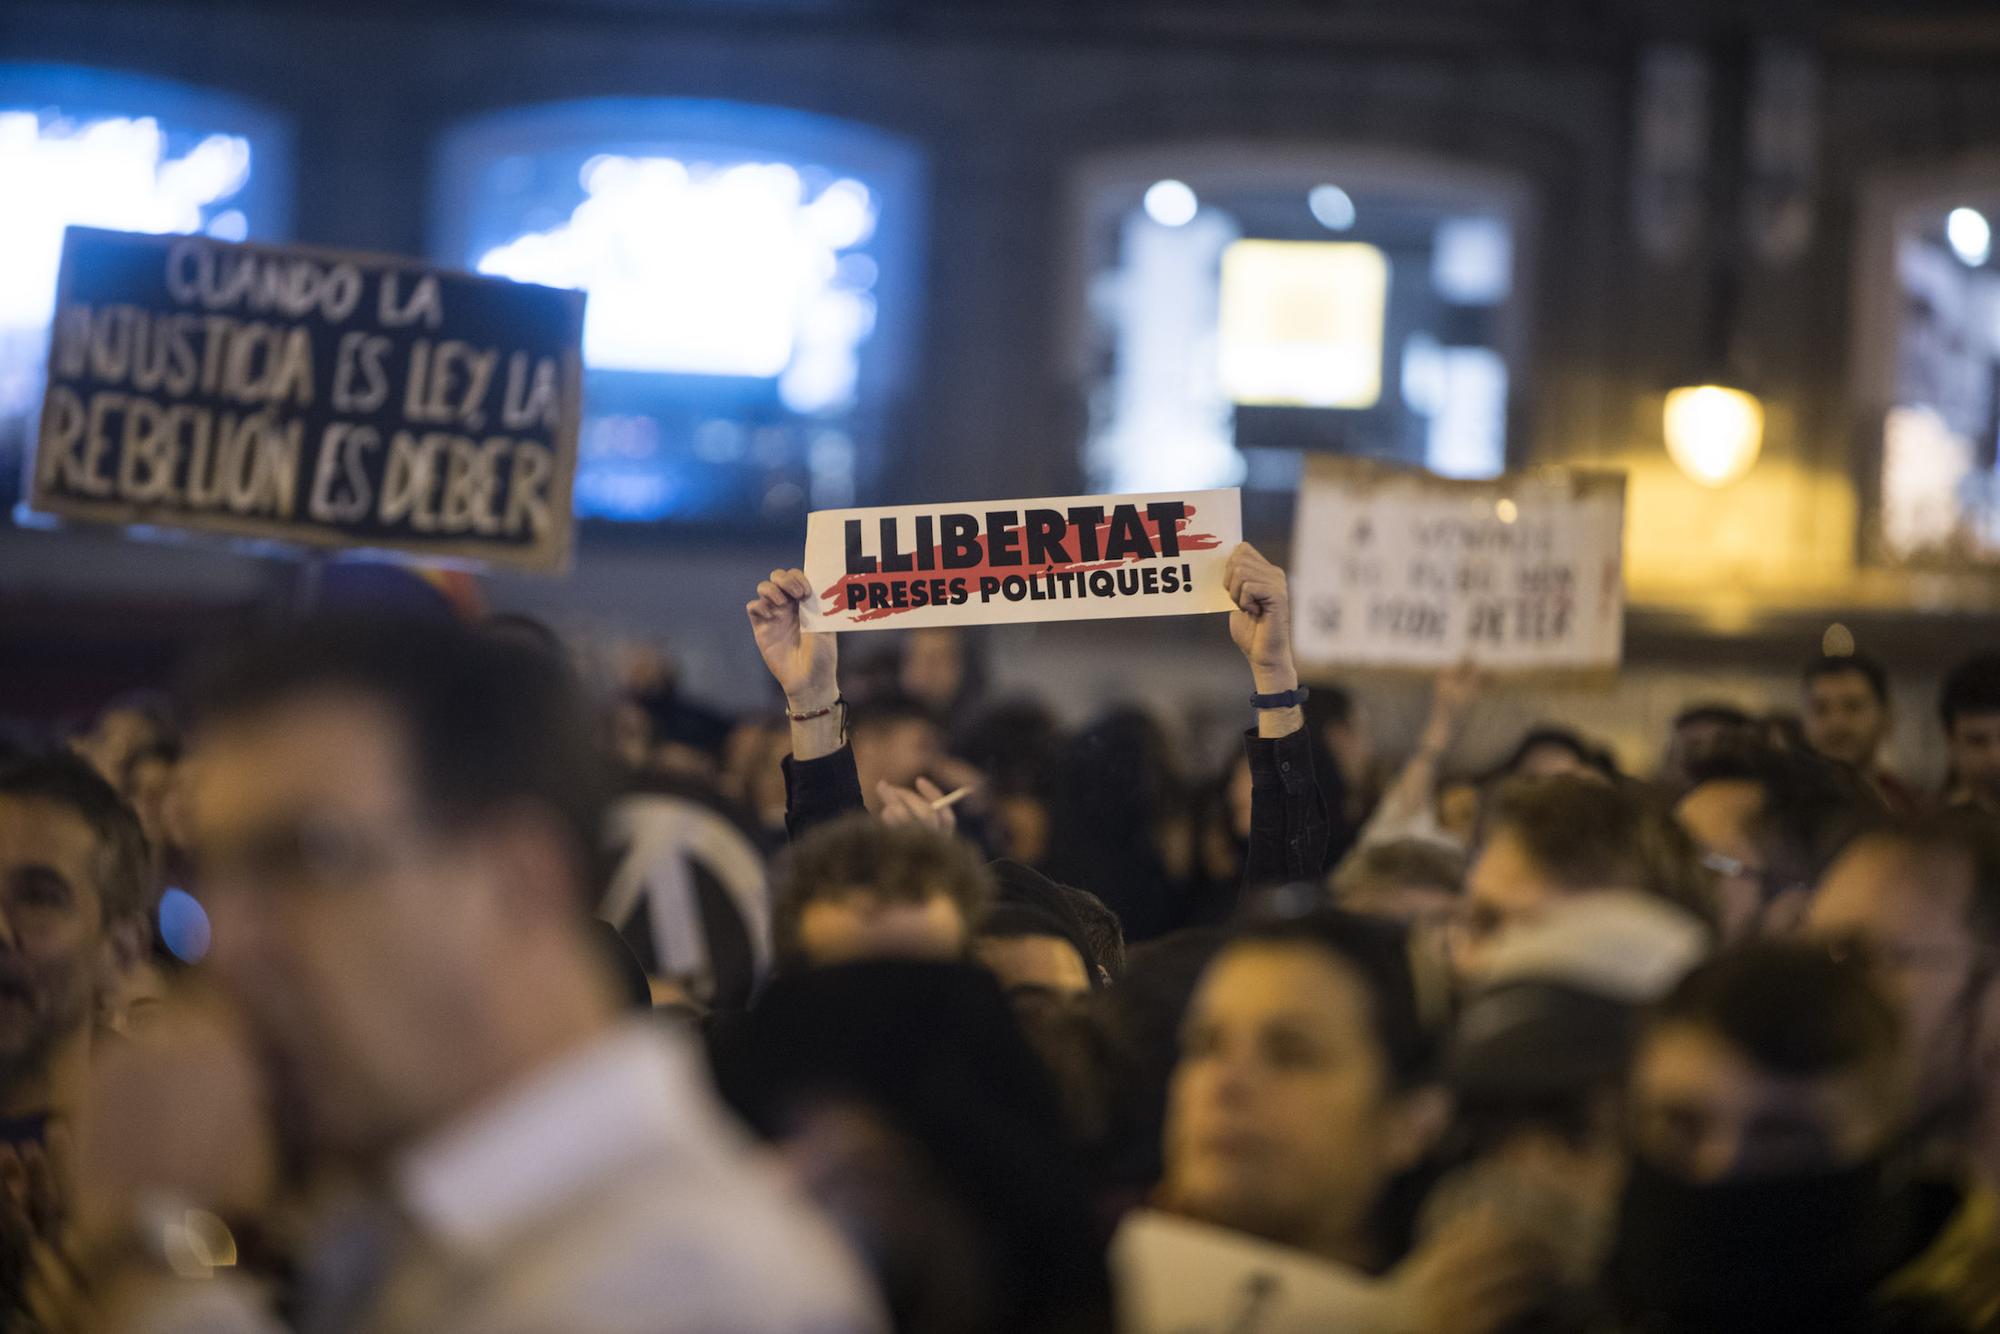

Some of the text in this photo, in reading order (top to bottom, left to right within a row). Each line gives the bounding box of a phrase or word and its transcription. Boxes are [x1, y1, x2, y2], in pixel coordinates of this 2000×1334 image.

[165, 240, 443, 330] CUANDO LA
[332, 330, 392, 414] ES
[501, 350, 560, 430] LA
[308, 420, 382, 525] ES
[378, 429, 553, 541] DEBER
[845, 501, 1185, 575] LLIBERTAT
[846, 564, 1193, 610] PRESES POLÍTIQUES!
